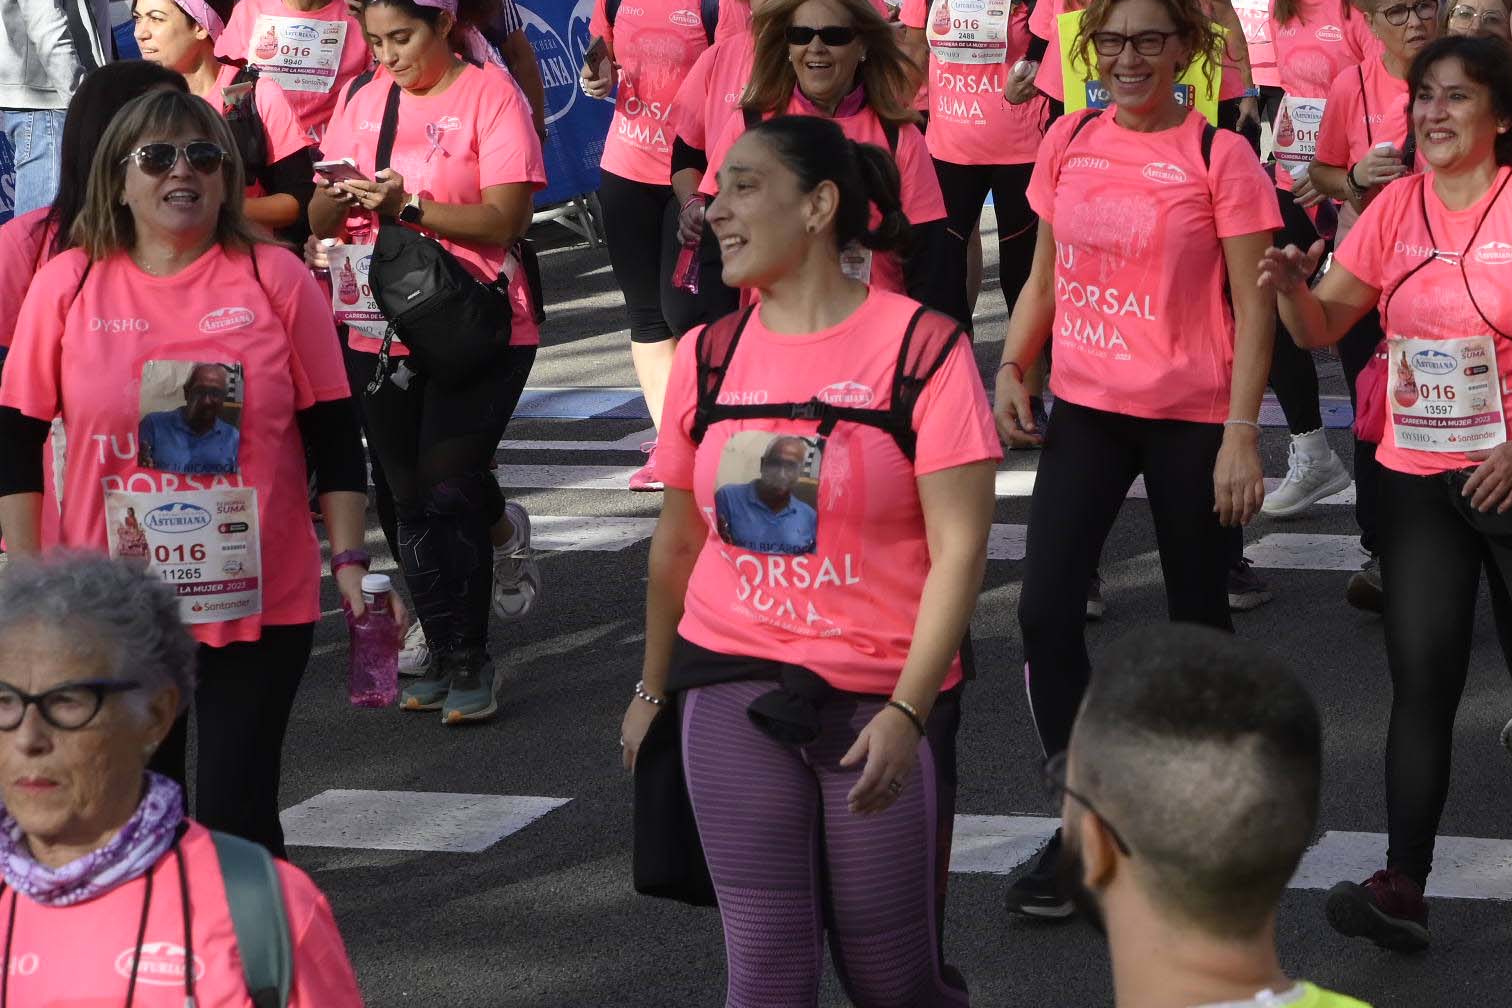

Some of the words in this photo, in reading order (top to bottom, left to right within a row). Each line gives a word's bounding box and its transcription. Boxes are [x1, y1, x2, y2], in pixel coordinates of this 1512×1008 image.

[953, 18, 979, 30] 016
[281, 45, 311, 57] 016
[937, 95, 983, 118] SUMA
[1067, 157, 1110, 170] OYSHO
[90, 317, 149, 333] OYSHO
[1461, 351, 1486, 360] SUMA
[1415, 359, 1454, 370] ASTURIANA
[1420, 383, 1456, 400] 016
[1424, 405, 1453, 415] 13597
[1401, 417, 1428, 425] CARRERA
[1447, 418, 1472, 426] MUJER
[1401, 432, 1431, 443] OYSHO
[1457, 431, 1496, 443] Santander
[90, 433, 136, 464] TU
[216, 504, 246, 514] SUMA
[149, 515, 207, 527] ASTURIANA
[155, 543, 206, 563] 016
[162, 568, 202, 580] 11265
[724, 552, 861, 590] ORSAL
[197, 584, 224, 593] MUJER
[227, 582, 246, 591] 2023
[204, 599, 250, 612] Santander
